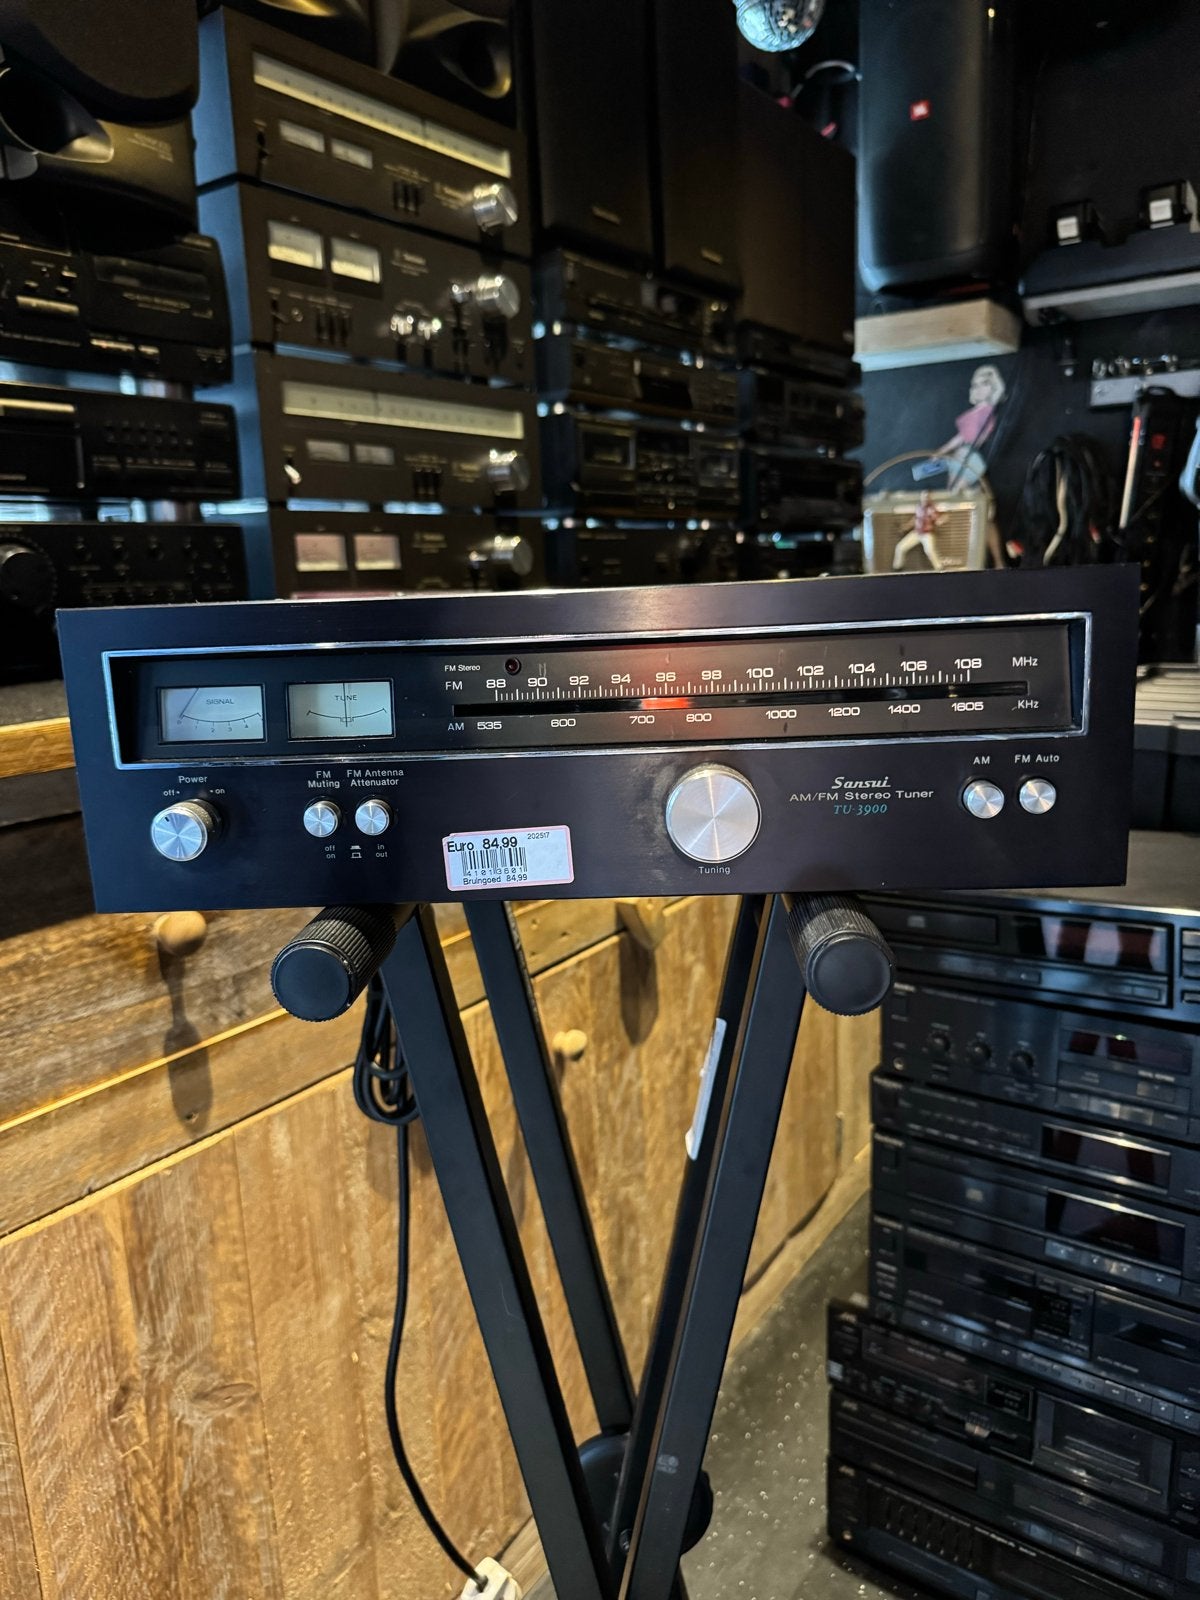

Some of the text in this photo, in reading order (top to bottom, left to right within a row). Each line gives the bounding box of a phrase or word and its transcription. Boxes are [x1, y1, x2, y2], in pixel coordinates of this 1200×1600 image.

[458, 663, 480, 672] Stereo
[445, 656, 1038, 691] FM 88 90 92 94 96 98 100 102 104 106 108 MHz
[448, 700, 1039, 732] AM 535 600 700 800 1000 1200 1400 1605 KHz
[973, 756, 990, 765] AM
[1014, 754, 1060, 764] FM Auto
[347, 768, 404, 778] FM Antenna
[178, 775, 208, 784] Power
[308, 780, 340, 789] Muting
[350, 778, 399, 787] Attenuator
[832, 776, 891, 789] Sansui
[790, 790, 934, 802] AM/FM Stereo Tuner
[834, 804, 888, 815] TU-3900
[447, 840, 474, 852] Euro
[699, 866, 731, 875] Tuning
[463, 874, 527, 885] Bruingoed 84,99
